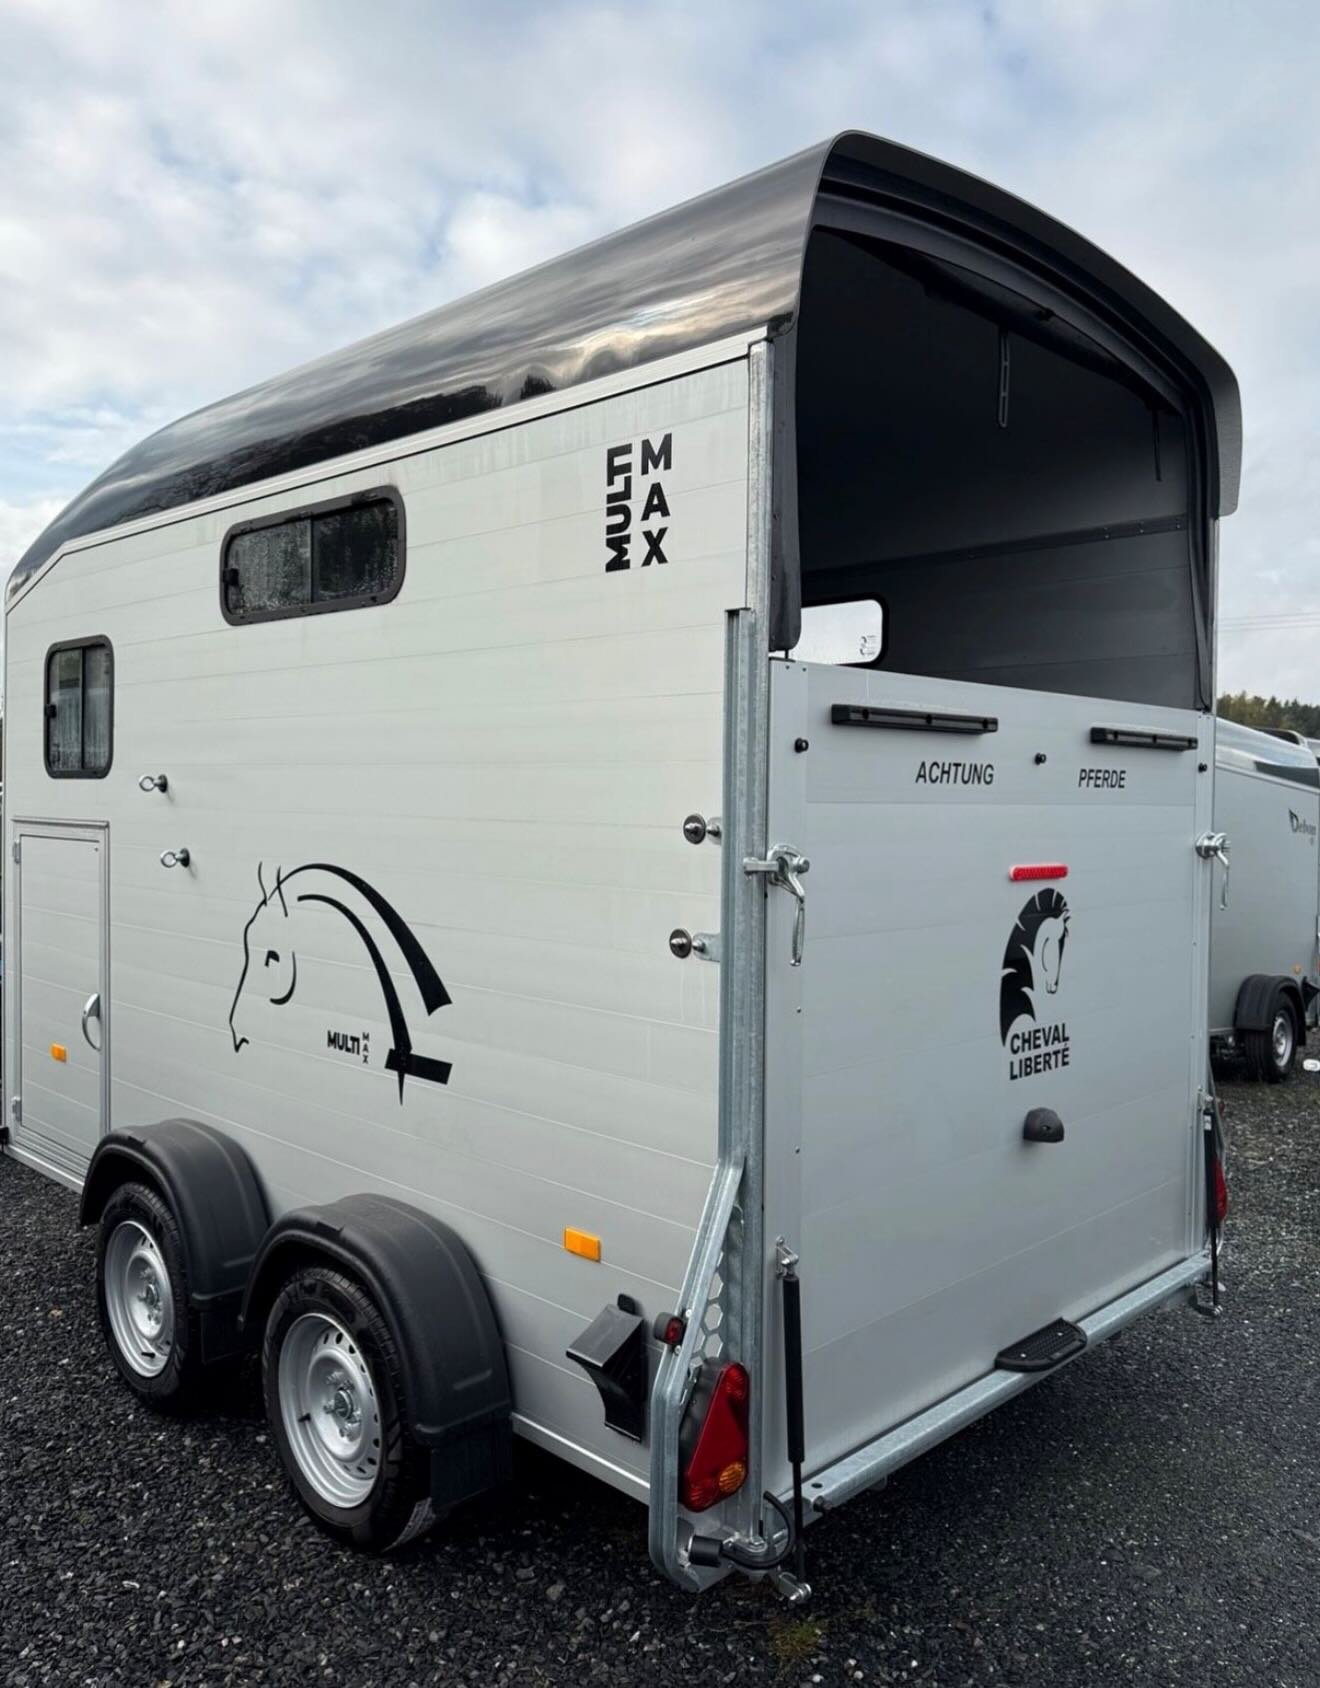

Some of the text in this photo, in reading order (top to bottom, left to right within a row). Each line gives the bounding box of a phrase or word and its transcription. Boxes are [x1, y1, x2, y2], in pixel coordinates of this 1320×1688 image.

[640, 433, 672, 567] MAX
[915, 761, 1126, 788] ACHTUNG PFERDE
[327, 1030, 360, 1055] MULTI
[1010, 1022, 1070, 1055] CHEVAL
[1010, 1043, 1070, 1081] LIBERTÉ
